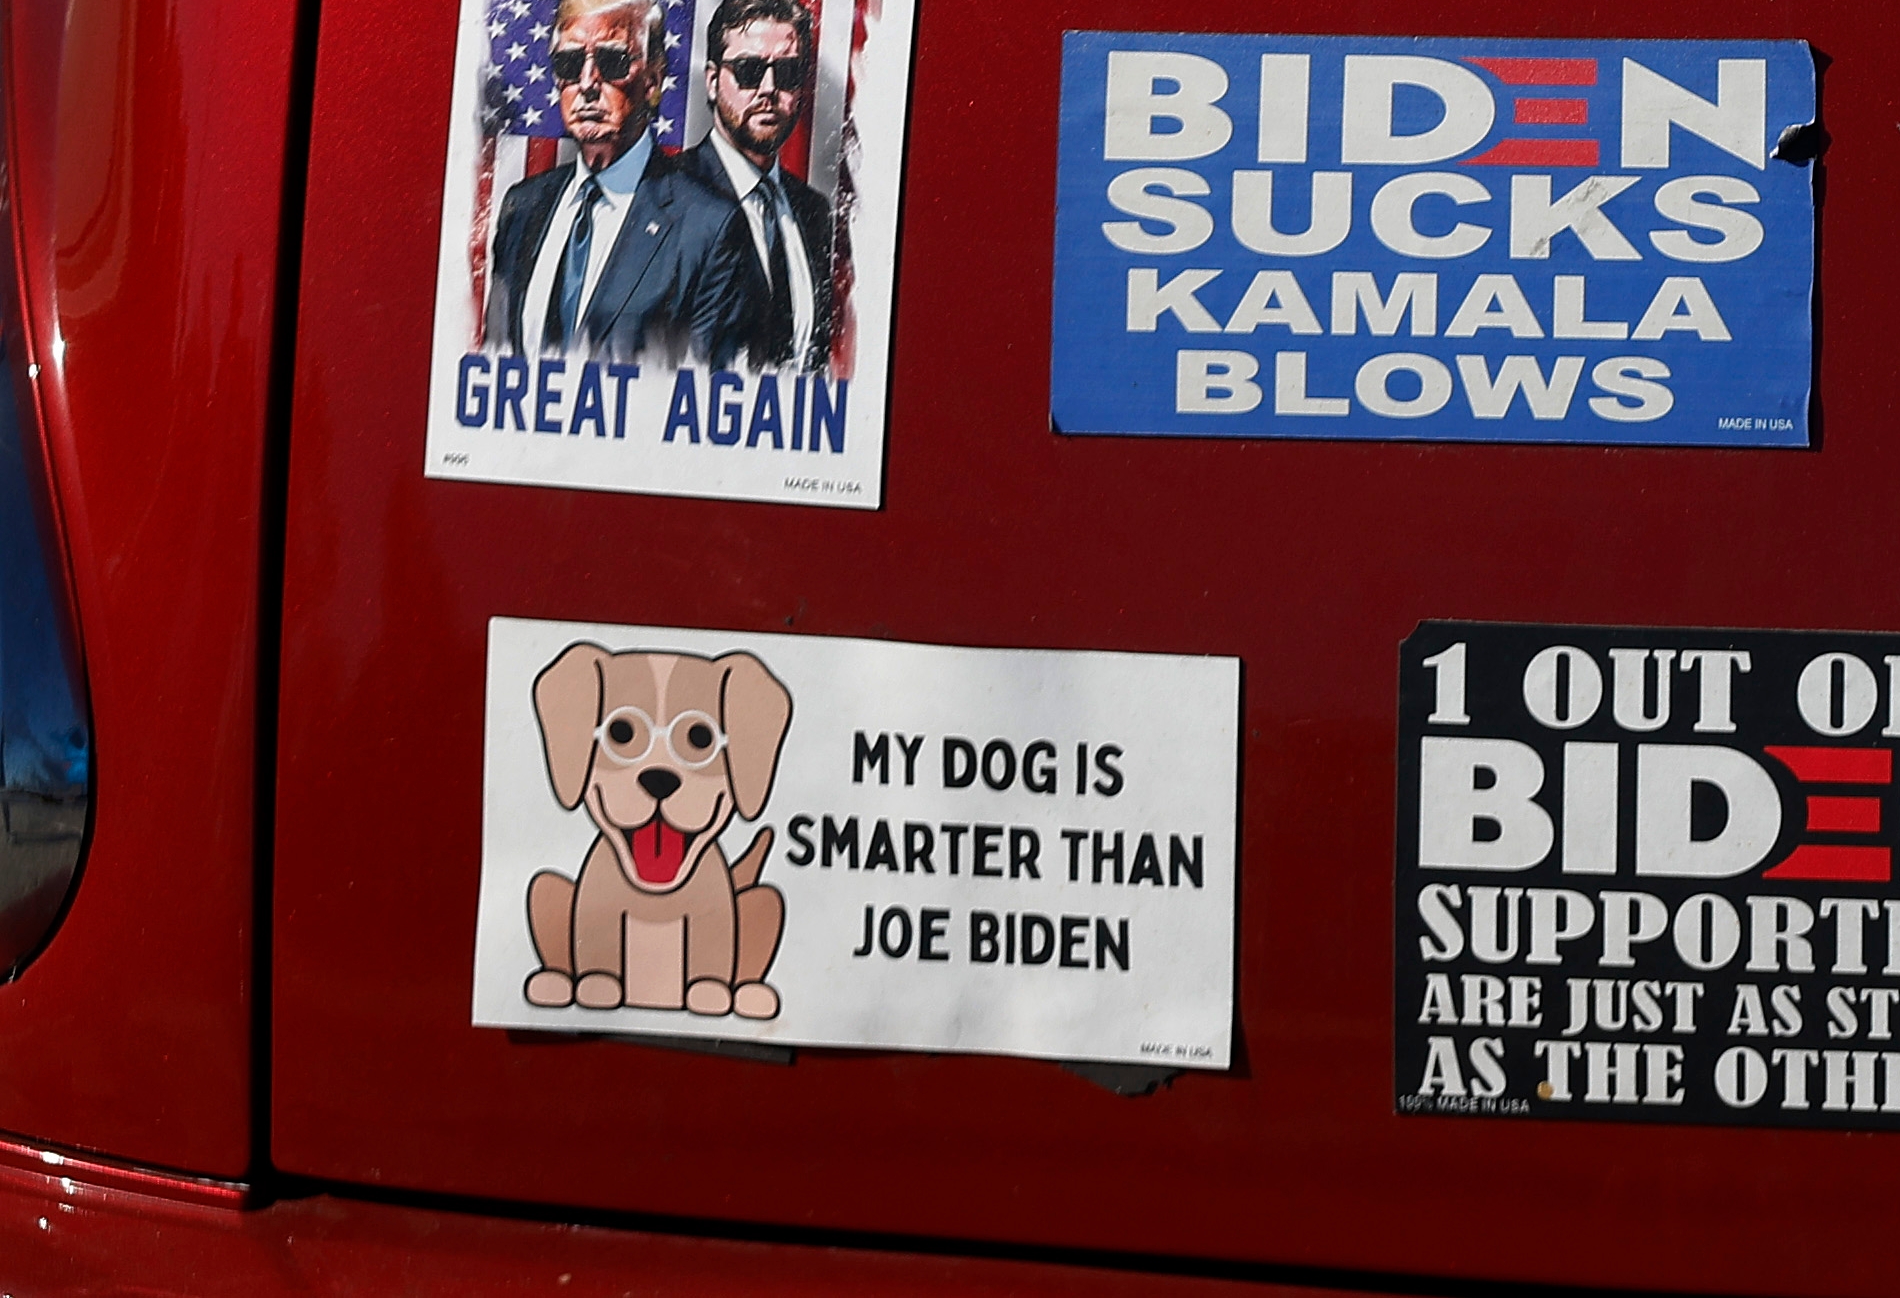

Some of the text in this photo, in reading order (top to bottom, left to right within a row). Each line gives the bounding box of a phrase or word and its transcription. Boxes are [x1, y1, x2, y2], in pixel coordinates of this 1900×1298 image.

[1104, 51, 1767, 170] BIDEN
[1102, 168, 1764, 262] SUCKS
[1127, 269, 1732, 341] KAMALA
[455, 352, 850, 455] GREAT AGAIN
[1176, 350, 1673, 422] BLOWS
[1423, 643, 1470, 724] 1
[1523, 646, 1751, 732] OUT
[853, 731, 1123, 797] MY DOG IS
[787, 815, 1203, 888] SMARTER THAN
[854, 906, 1129, 971] JOE BIDEN
[1418, 974, 1542, 1027] ARE
[1562, 979, 1704, 1035] JUST
[1727, 984, 1802, 1038] AS
[1418, 1035, 1507, 1099] AS
[1535, 1041, 1684, 1104] THE
